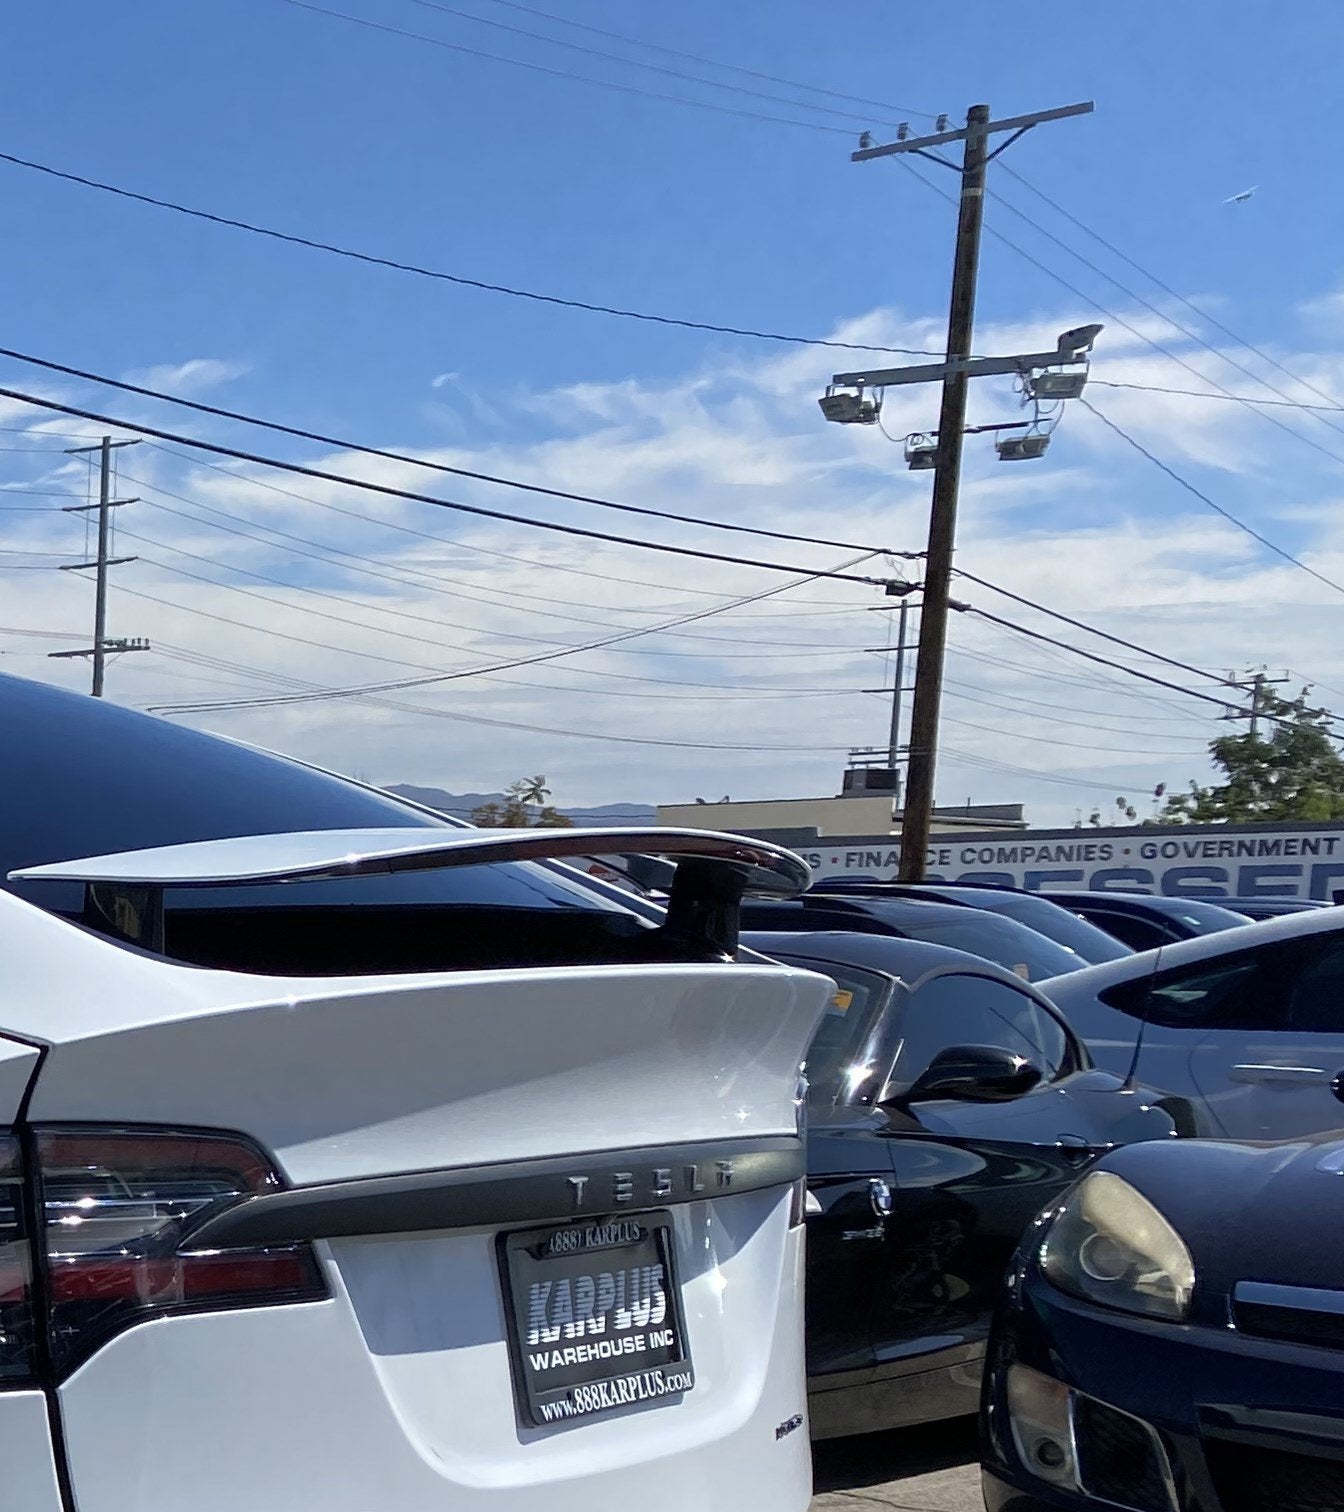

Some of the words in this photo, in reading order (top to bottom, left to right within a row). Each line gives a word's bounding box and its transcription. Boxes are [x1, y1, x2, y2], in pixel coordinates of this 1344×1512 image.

[845, 849, 951, 868] FINACE
[960, 843, 1114, 865] COMPANIES
[1140, 837, 1341, 860] GOVERNMENT
[568, 1160, 734, 1206] TESLA
[549, 1232, 582, 1252] (888)
[585, 1222, 641, 1248] KARPLUS
[525, 1263, 667, 1345] KARPLUS
[529, 1334, 646, 1371] WAREHOUSE
[649, 1329, 675, 1350] INC
